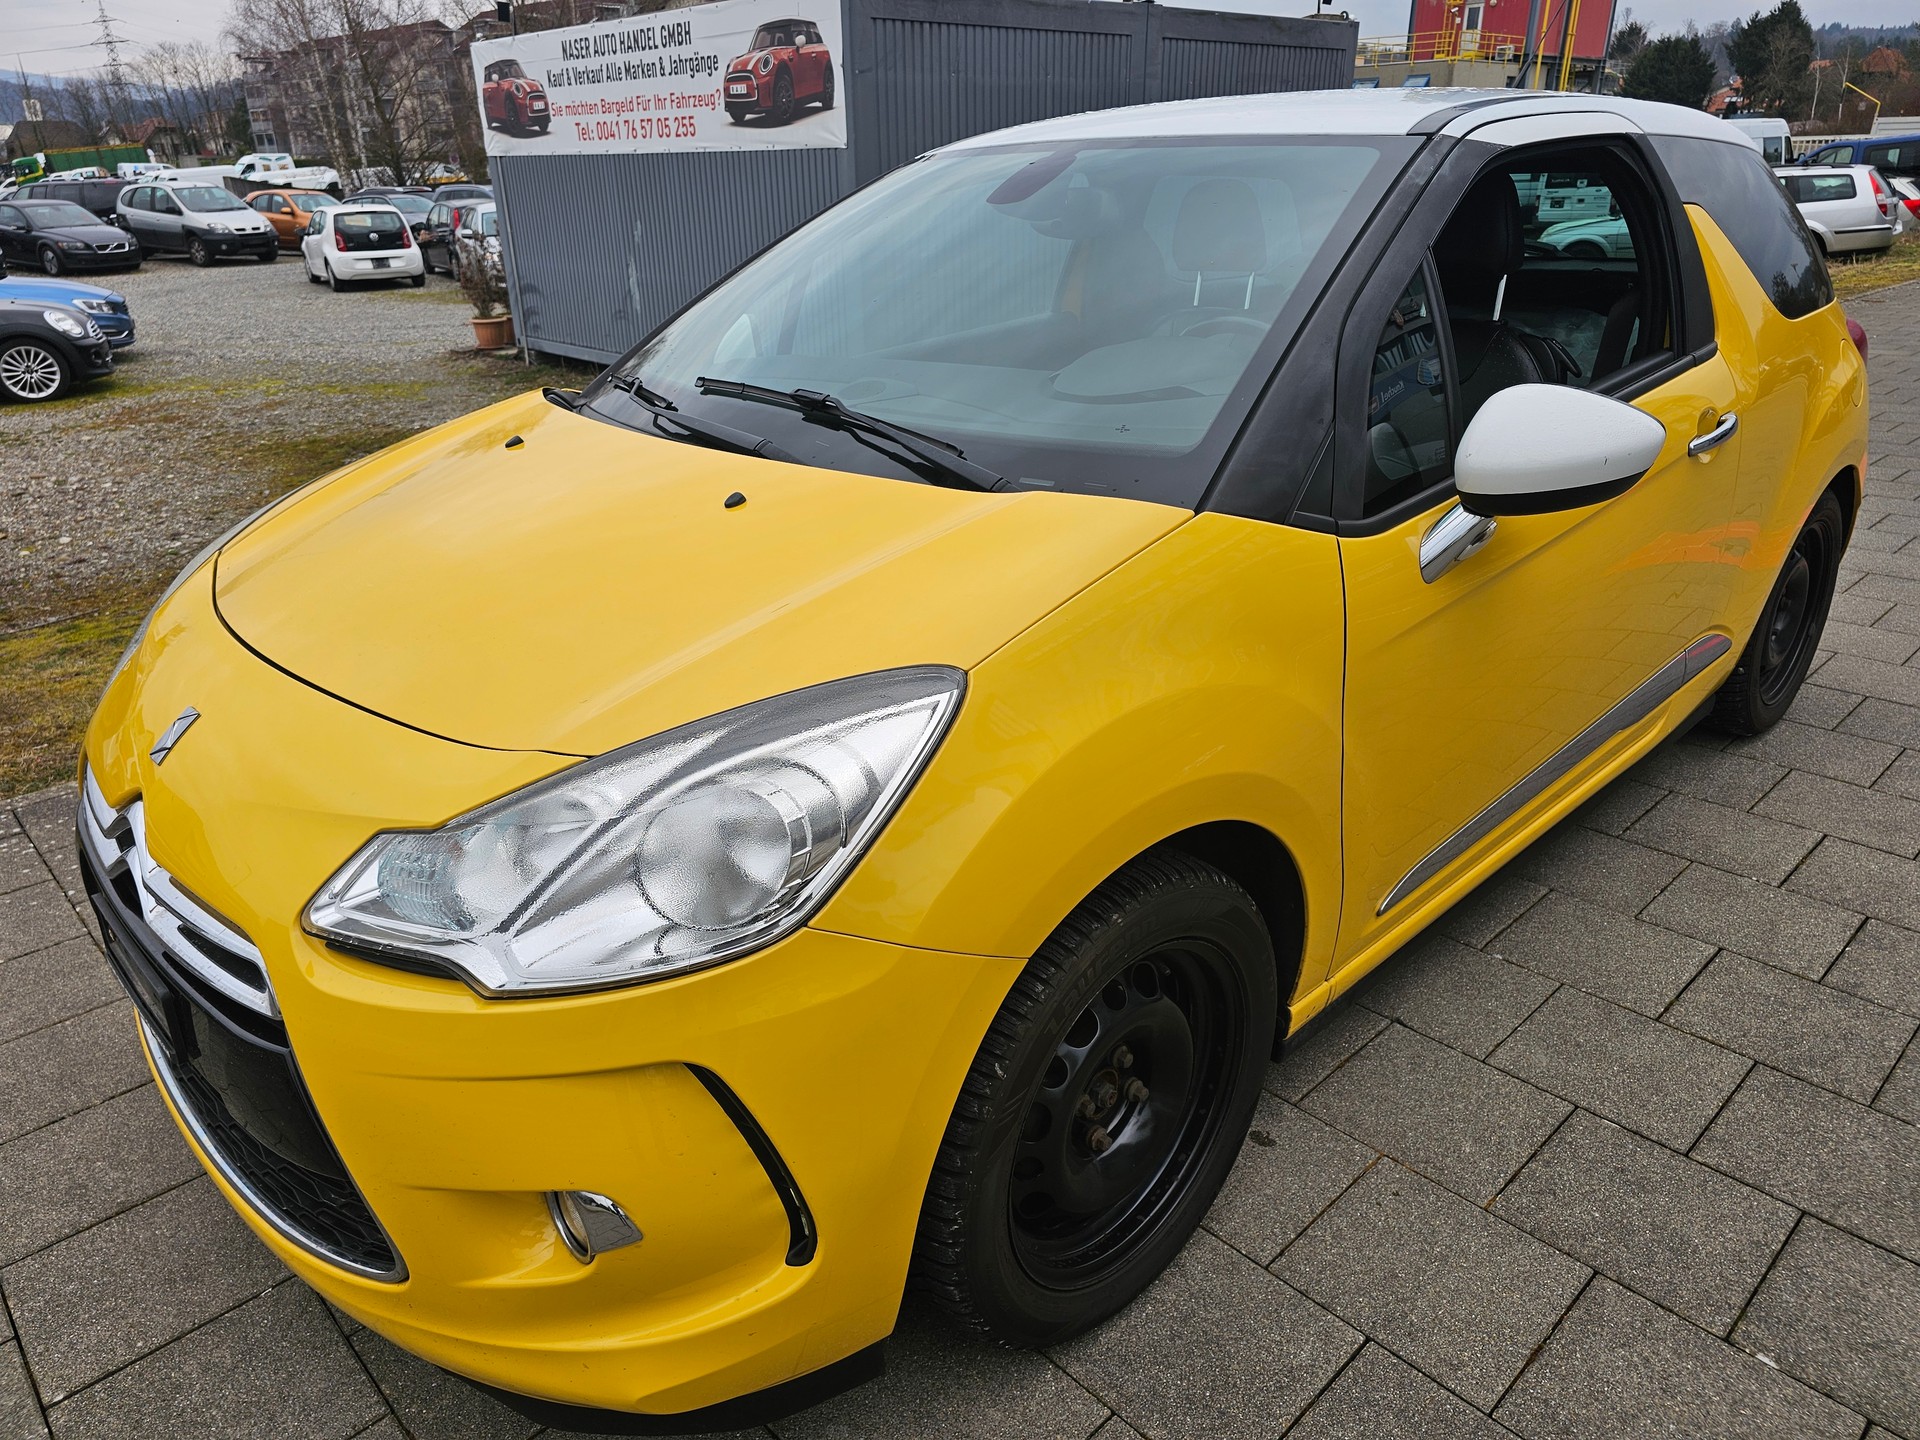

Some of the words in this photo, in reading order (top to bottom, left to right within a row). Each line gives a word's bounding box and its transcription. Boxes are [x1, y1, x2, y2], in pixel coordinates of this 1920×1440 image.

[561, 37, 592, 61] NASER
[593, 33, 617, 58] AUTO
[619, 26, 659, 54] HANDEL
[660, 21, 692, 49] GMBH
[546, 68, 565, 88] Kauf
[566, 67, 572, 86] &
[572, 63, 604, 86] Verkauf
[606, 62, 623, 83] Alle
[623, 58, 658, 81] Marken
[659, 56, 666, 77] &
[668, 51, 719, 79] Jahrgänge
[551, 101, 563, 117] Sie
[565, 100, 599, 116] möchten
[600, 96, 634, 117] Bargeld
[636, 94, 651, 112] Für
[653, 93, 667, 111] Ihr
[669, 88, 721, 111] Fahrzeug?
[575, 121, 595, 141] Tel:
[596, 120, 621, 140] 0041
[623, 119, 638, 139] 76
[640, 118, 653, 139] 57
[656, 117, 671, 138] 05
[673, 115, 696, 138] 255
